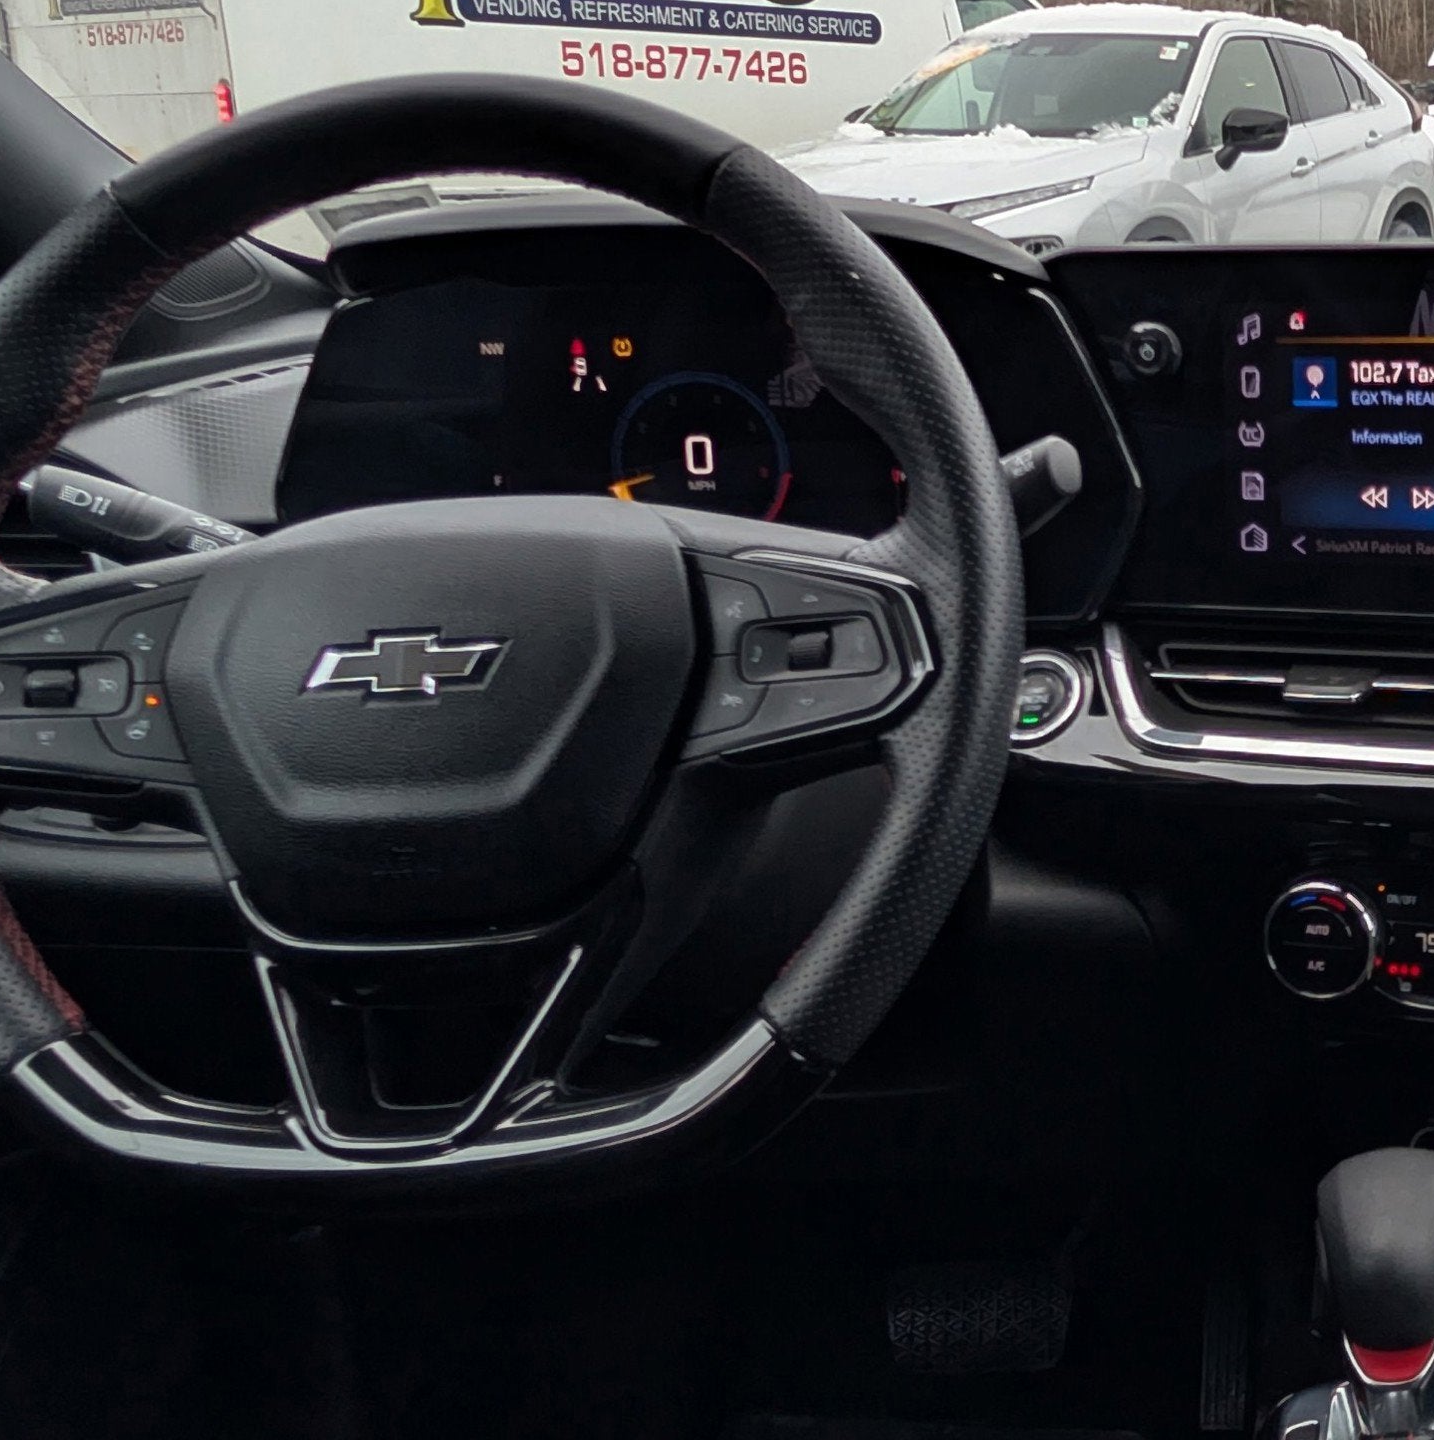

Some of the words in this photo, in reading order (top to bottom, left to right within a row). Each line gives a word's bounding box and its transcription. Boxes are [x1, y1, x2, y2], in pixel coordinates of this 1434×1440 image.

[569, 0, 704, 29] REFRESHMENT
[708, 10, 721, 29] &
[724, 9, 805, 35] CATERING
[806, 15, 874, 39] SERVICE
[86, 20, 186, 47] 518-877-7426
[560, 39, 808, 84] 518-877-7426
[478, 341, 506, 356] NW
[1350, 361, 1403, 384] 102.7
[1351, 390, 1379, 406] EQX
[1380, 390, 1404, 406] The
[1351, 428, 1423, 445] Information
[683, 433, 714, 476] 0
[687, 479, 716, 491] MPH
[1370, 540, 1412, 555] Patriot
[1305, 924, 1331, 936] AUTO
